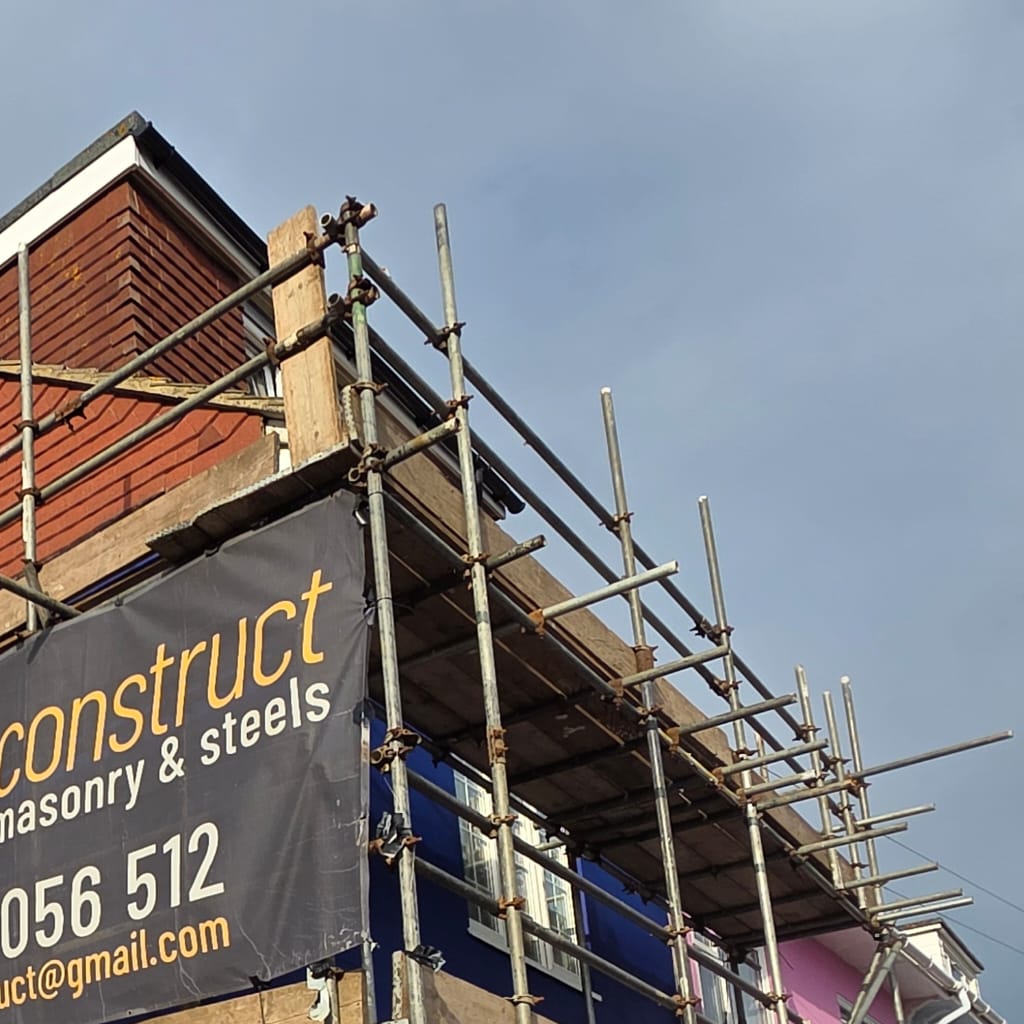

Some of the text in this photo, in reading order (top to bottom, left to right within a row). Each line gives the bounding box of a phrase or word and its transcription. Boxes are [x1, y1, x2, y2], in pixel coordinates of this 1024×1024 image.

[158, 735, 185, 784] &
[200, 677, 331, 766] steels
[0, 865, 102, 959] 056
[126, 822, 225, 921] 512
